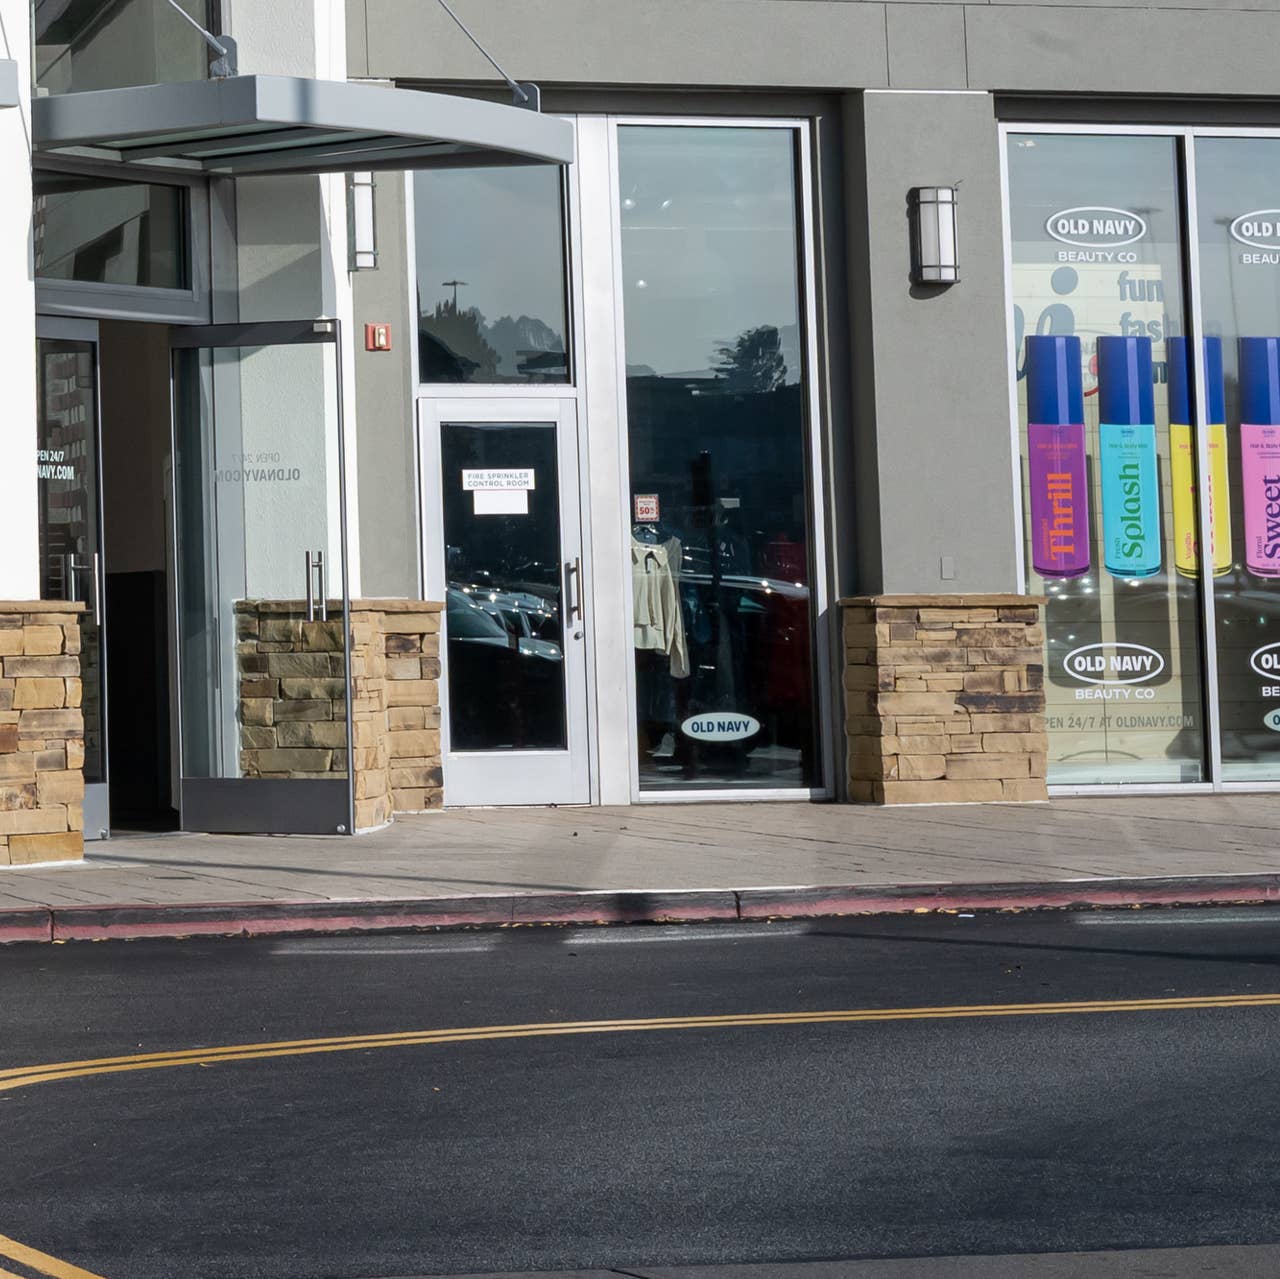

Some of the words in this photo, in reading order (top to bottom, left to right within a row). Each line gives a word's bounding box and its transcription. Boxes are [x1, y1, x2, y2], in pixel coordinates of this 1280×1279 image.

[1057, 219, 1090, 235] OLD
[1093, 219, 1136, 235] NAVY
[1241, 222, 1273, 237] OLD
[1058, 251, 1114, 263] BEAUTY
[1117, 251, 1137, 263] CO
[1117, 270, 1164, 302] fun
[37, 450, 49, 461] PEN
[50, 450, 65, 462] 24/7
[38, 464, 75, 480] NAVY.COM
[487, 472, 529, 480] SPRINKLER
[1047, 472, 1075, 561] Thrill
[1119, 463, 1146, 559] Splash
[1263, 474, 1280, 559] Sweet
[1074, 656, 1106, 671] OLD
[1110, 655, 1153, 671] NAVY
[1075, 688, 1131, 700] BEAUTY
[1135, 688, 1155, 699] CO
[691, 721, 715, 733] OLD
[717, 721, 750, 732] NAVY
[1044, 716, 1064, 728] PEN
[1067, 716, 1095, 730] 24/7
[1099, 715, 1113, 728] AT
[1116, 715, 1194, 728] OLDNAVY.COM
